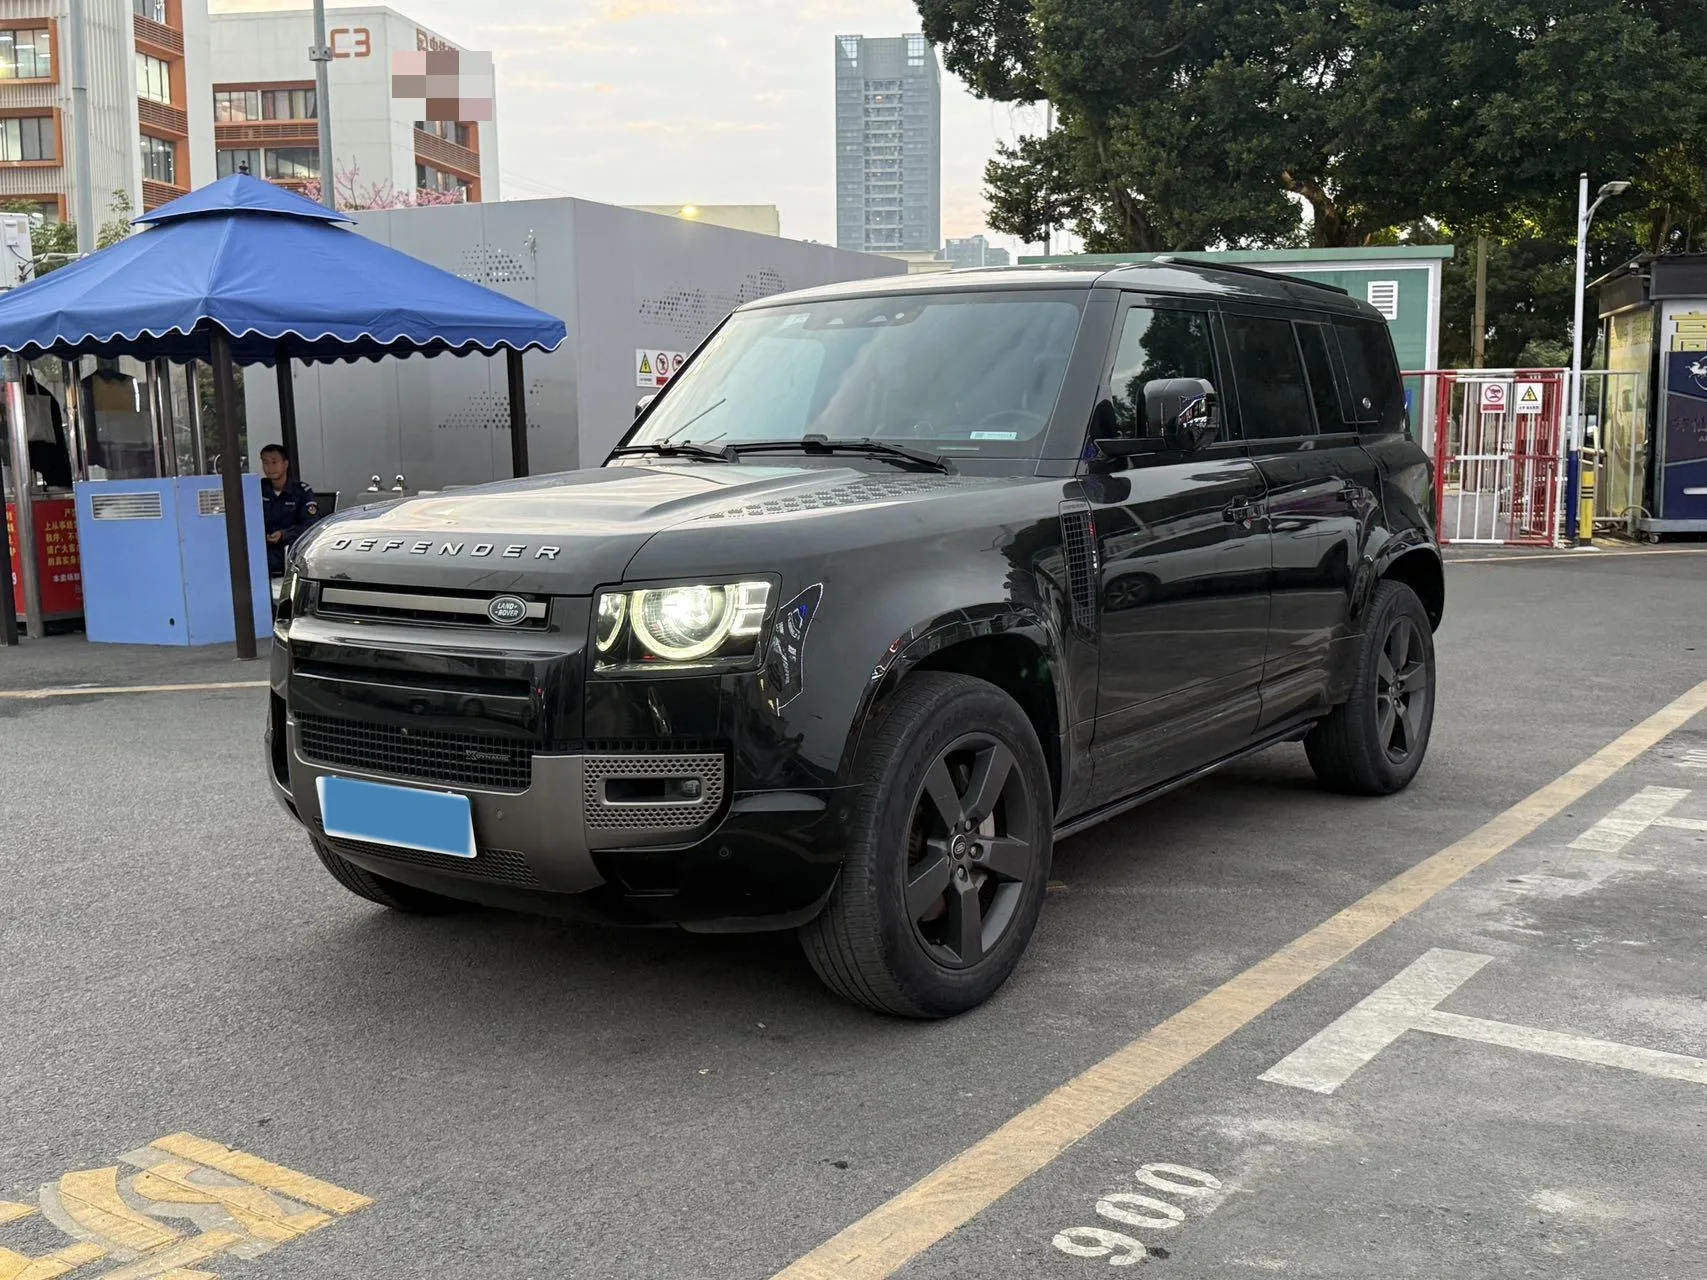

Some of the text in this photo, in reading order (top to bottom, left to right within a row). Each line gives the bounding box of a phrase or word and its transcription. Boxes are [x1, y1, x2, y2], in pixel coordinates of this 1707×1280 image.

[330, 28, 371, 58] C3
[330, 538, 562, 561] DEFENDER
[497, 602, 515, 610] LAND
[497, 609, 519, 617] ROVER
[1051, 1162, 1222, 1266] 900
